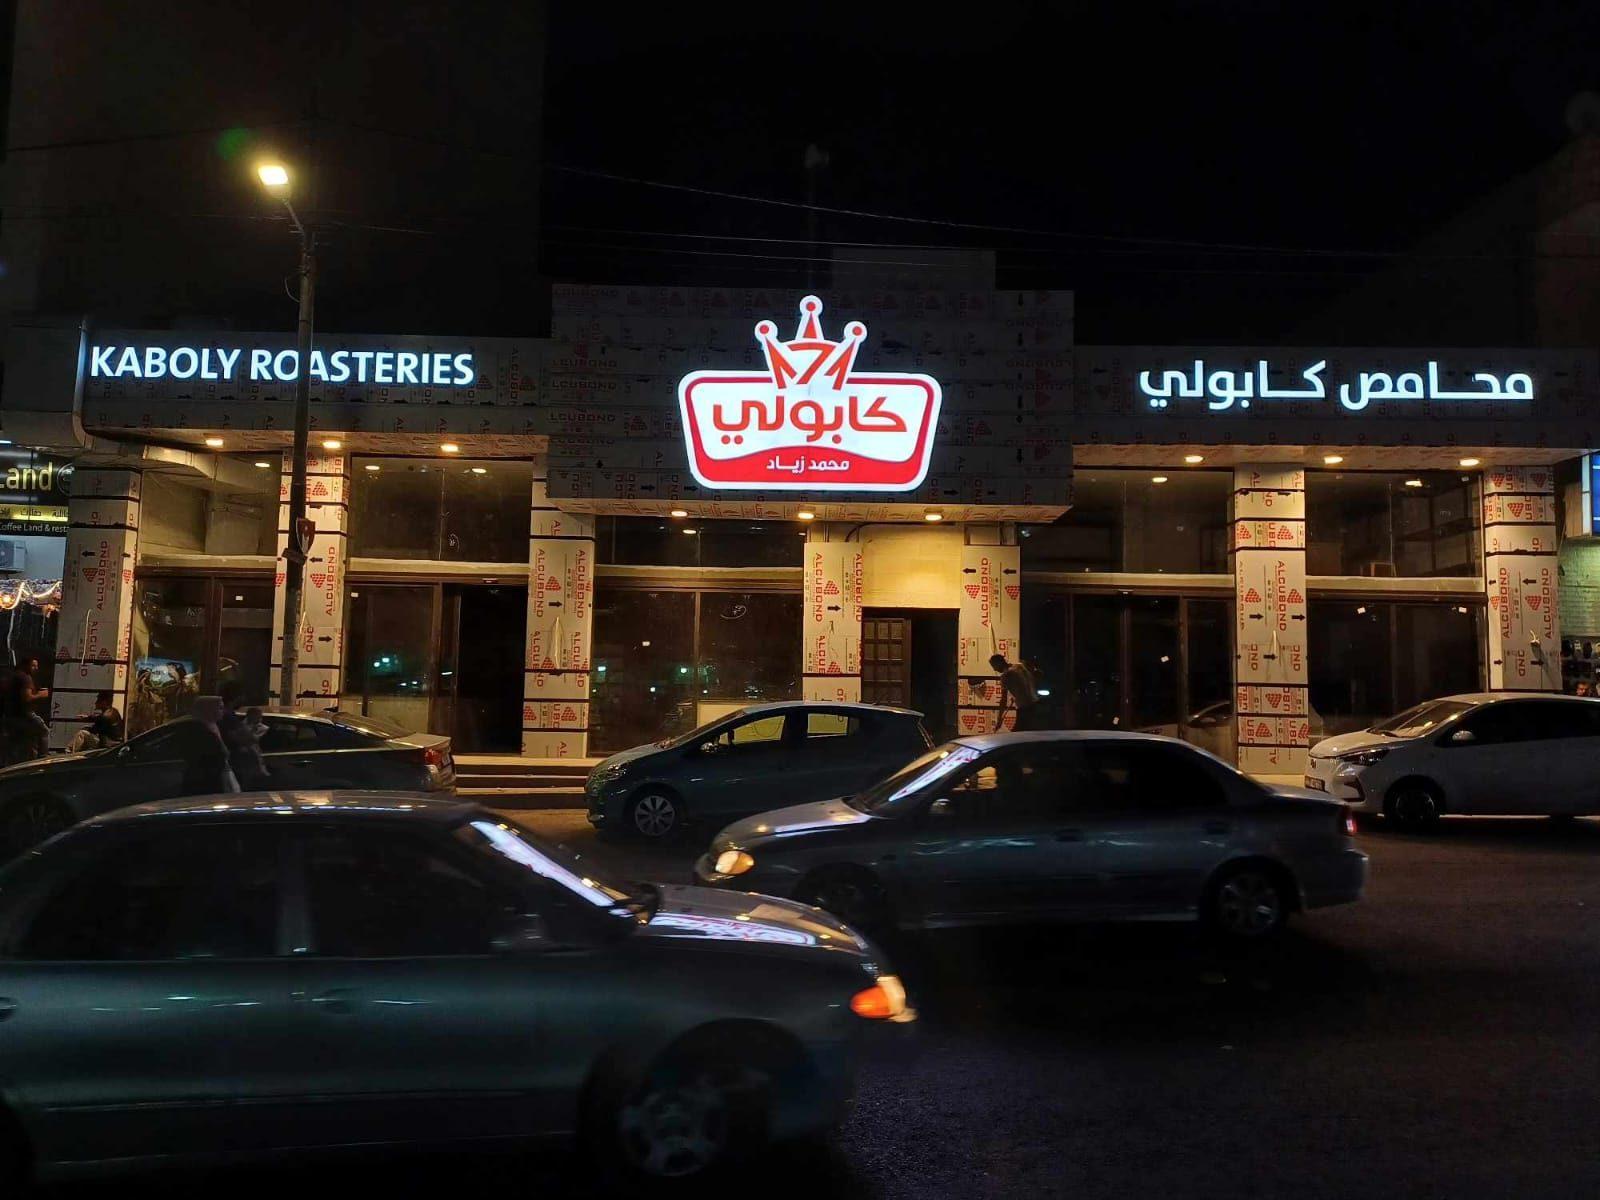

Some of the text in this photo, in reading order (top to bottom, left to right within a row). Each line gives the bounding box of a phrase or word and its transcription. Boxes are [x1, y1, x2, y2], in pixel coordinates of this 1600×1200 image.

[90, 346, 475, 385] KABOLY ROASTERIES
[1139, 360, 1326, 410] كابولي
[1340, 361, 1534, 411] محامص
[713, 396, 908, 445] كابولي
[0, 461, 53, 490] and
[766, 455, 850, 474] محمد زياد
[326, 546, 335, 616] ALCUBOND
[536, 549, 545, 618] ALCUBOND
[576, 549, 585, 618] ALCUBOND
[815, 553, 823, 622] ALCUBOND
[981, 557, 989, 627] ALCUBOND
[1278, 560, 1287, 631] ALCUBOND
[1500, 567, 1510, 638] ALCUBOND
[1541, 568, 1552, 639] ALCUBOND
